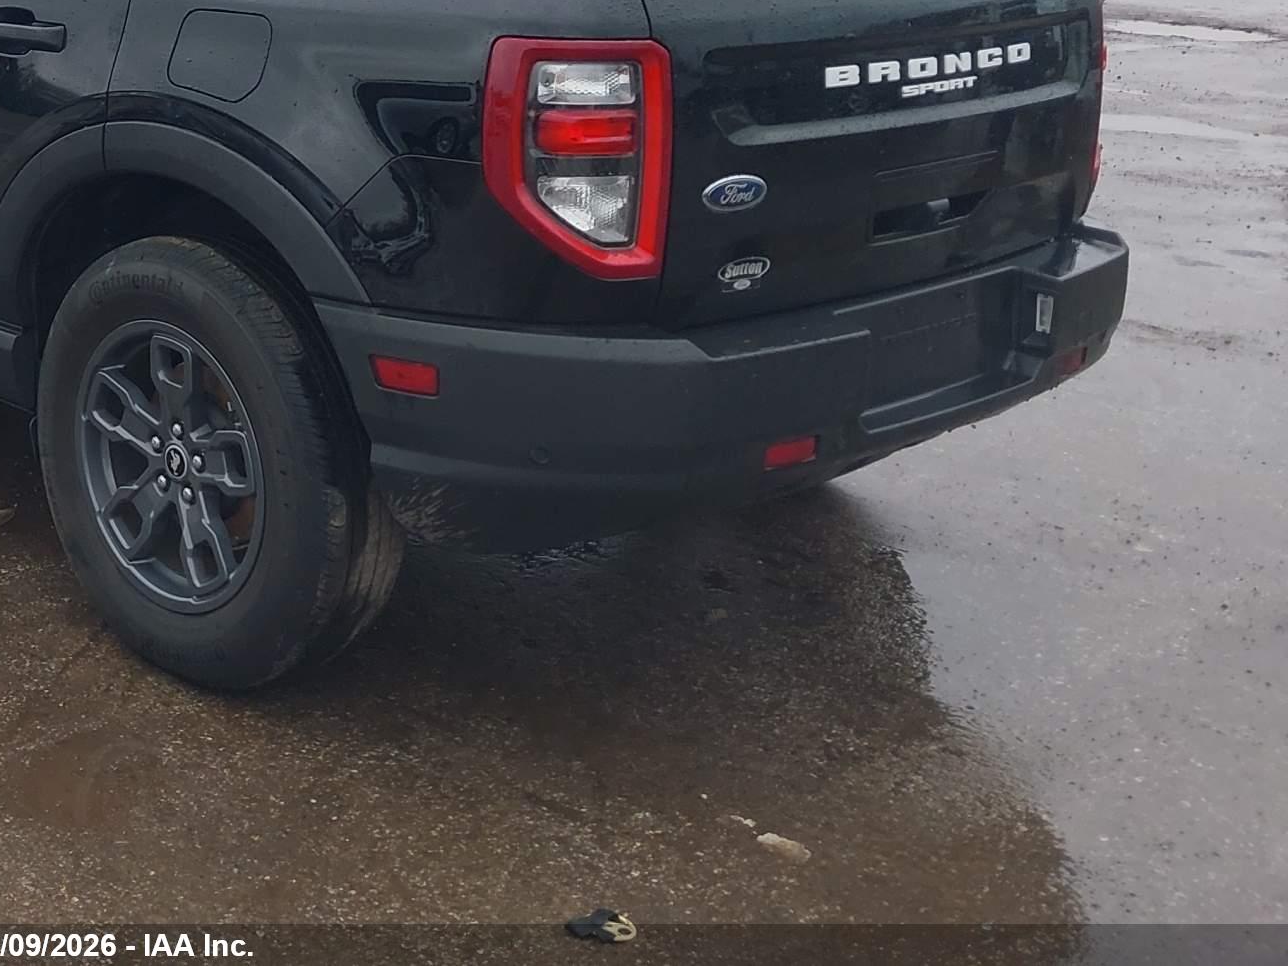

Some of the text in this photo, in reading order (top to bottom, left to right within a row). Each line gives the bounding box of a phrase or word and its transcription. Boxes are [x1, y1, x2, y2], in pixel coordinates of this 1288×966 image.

[825, 42, 1031, 89] BRONCO
[901, 76, 978, 98] SPORT
[724, 262, 764, 279] Sutton
